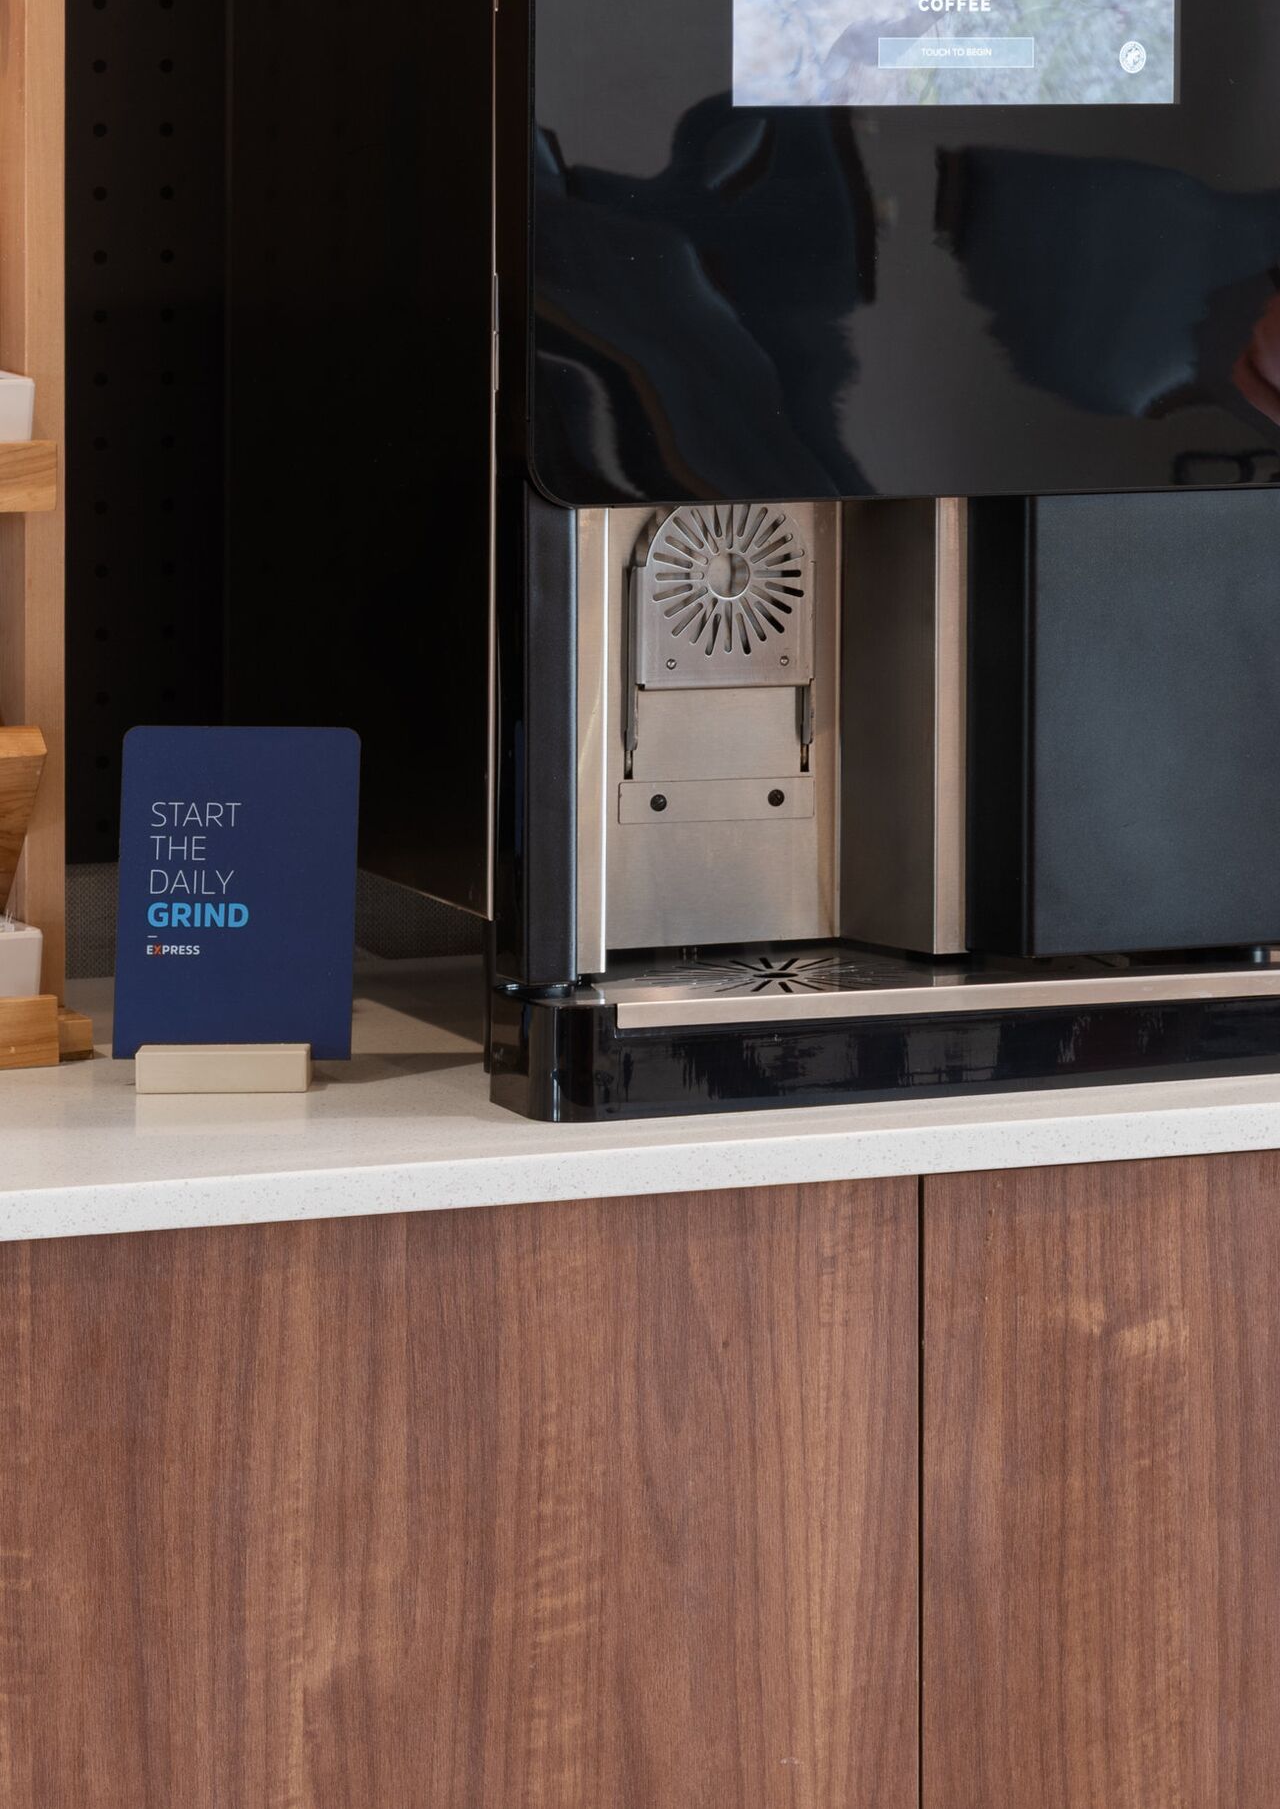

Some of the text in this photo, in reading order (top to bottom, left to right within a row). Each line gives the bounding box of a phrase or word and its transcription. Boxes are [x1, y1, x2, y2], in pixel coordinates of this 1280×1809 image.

[921, 48, 992, 56] TOUCH TO BEGIN
[151, 802, 242, 828] START
[150, 836, 206, 862] THE
[150, 869, 235, 895] DAILY
[147, 902, 249, 928] GRIND
[146, 945, 200, 955] EXPRESS
